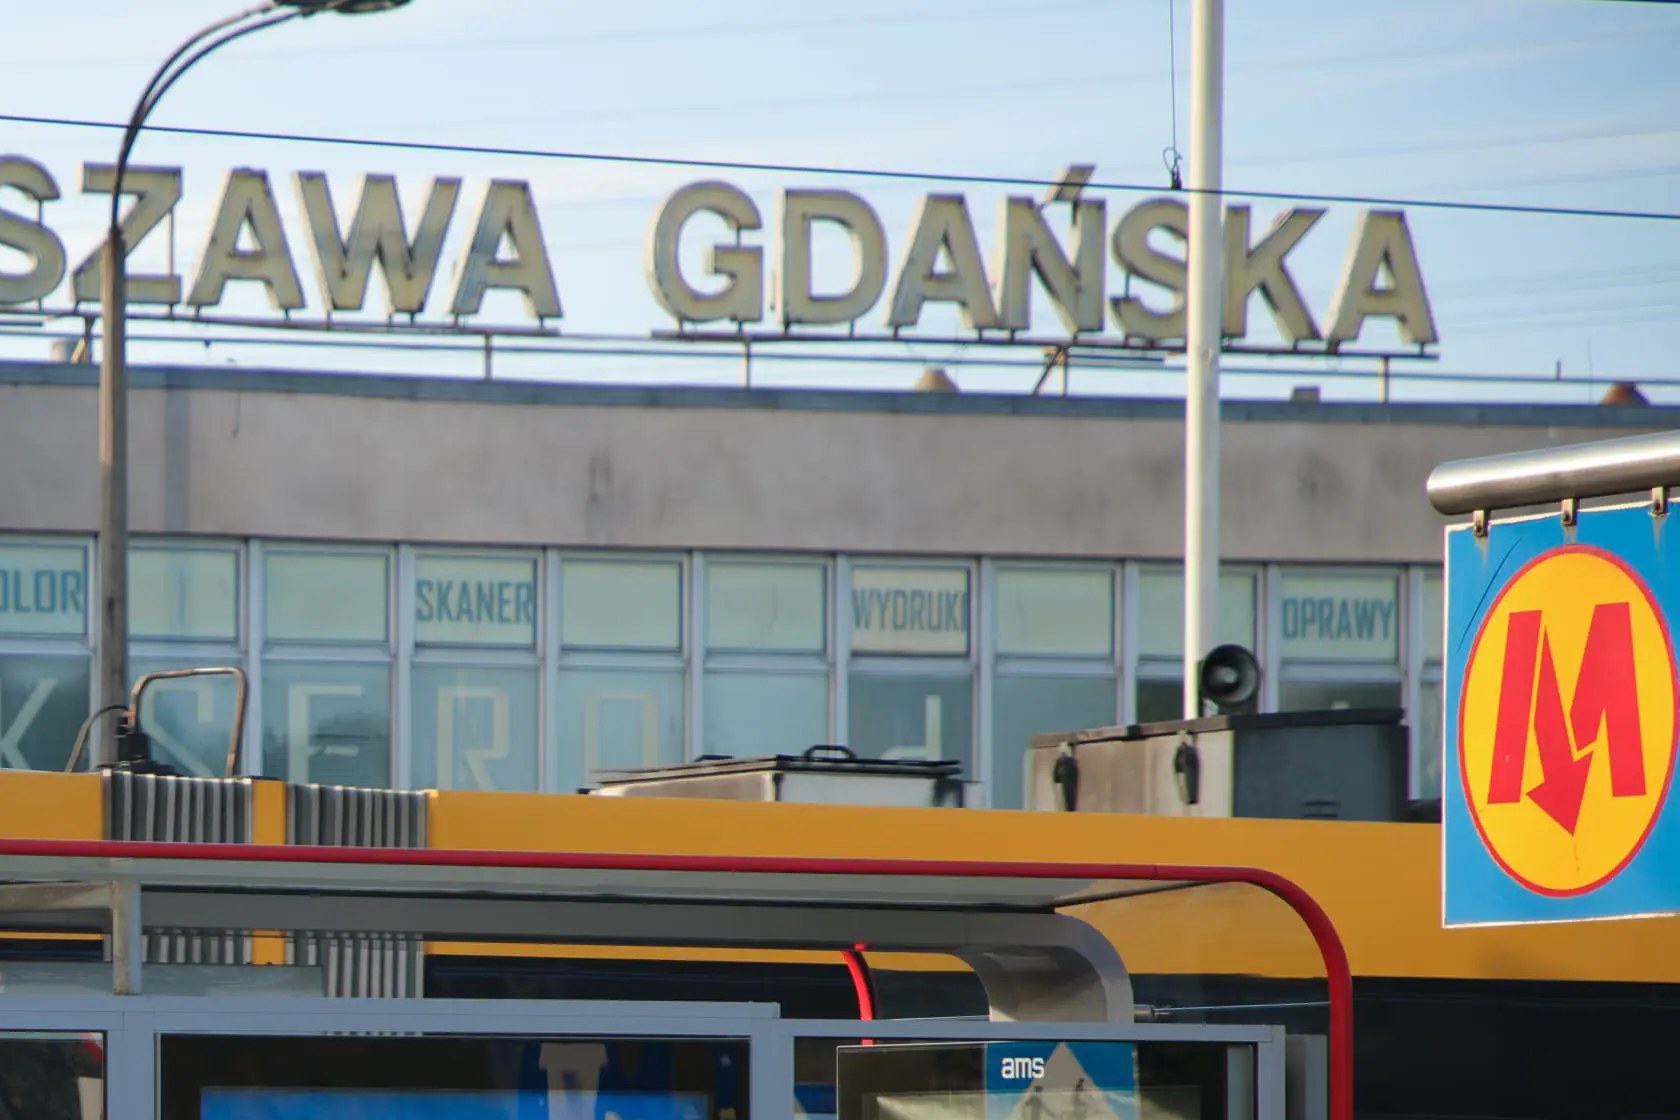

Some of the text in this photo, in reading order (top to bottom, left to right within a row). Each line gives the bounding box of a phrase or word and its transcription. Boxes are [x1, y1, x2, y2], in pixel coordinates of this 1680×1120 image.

[645, 163, 1438, 348] GDAŃSKA
[416, 579, 534, 624] SKANER
[1282, 598, 1394, 641] OPRAWY
[1001, 1056, 1045, 1080] ams
